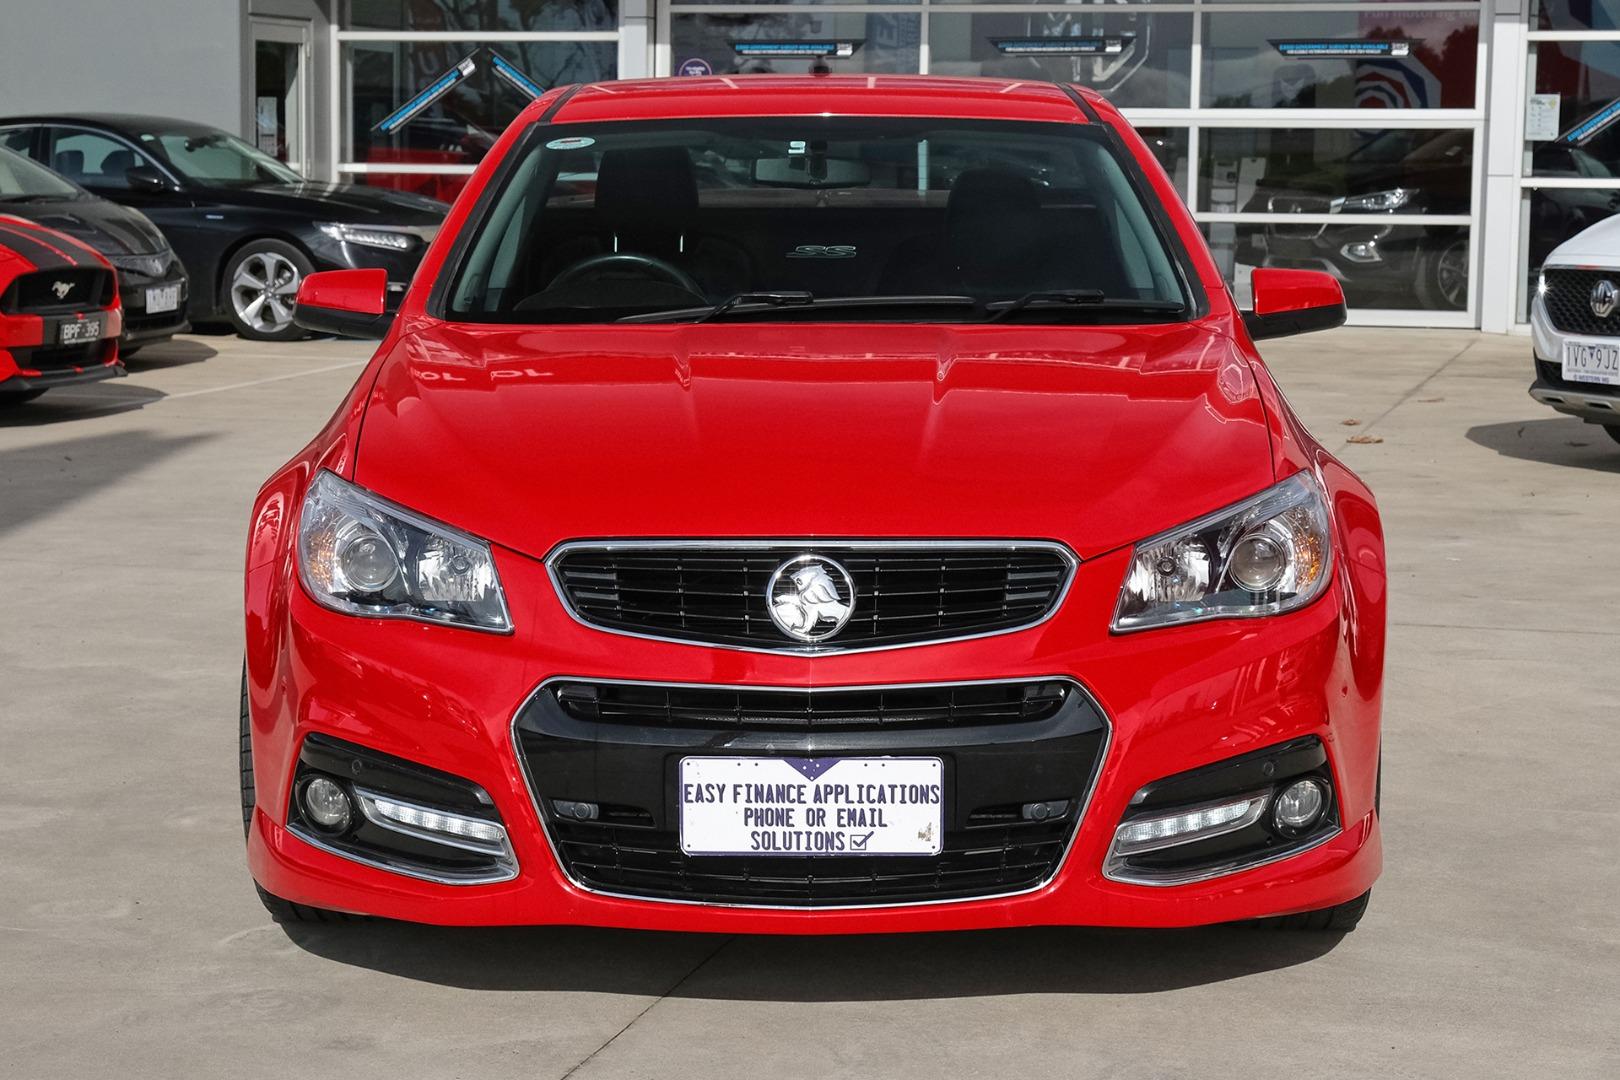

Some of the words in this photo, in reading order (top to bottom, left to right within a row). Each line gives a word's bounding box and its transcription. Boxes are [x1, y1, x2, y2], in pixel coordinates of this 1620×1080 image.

[683, 783, 727, 804] EASY
[733, 783, 808, 804] FINANCE
[812, 783, 941, 805] APPLICATIONS
[743, 807, 796, 828] PHONE
[805, 807, 827, 828] OR
[836, 807, 889, 828] EMAIL
[750, 830, 846, 851] SOLUTIONS
